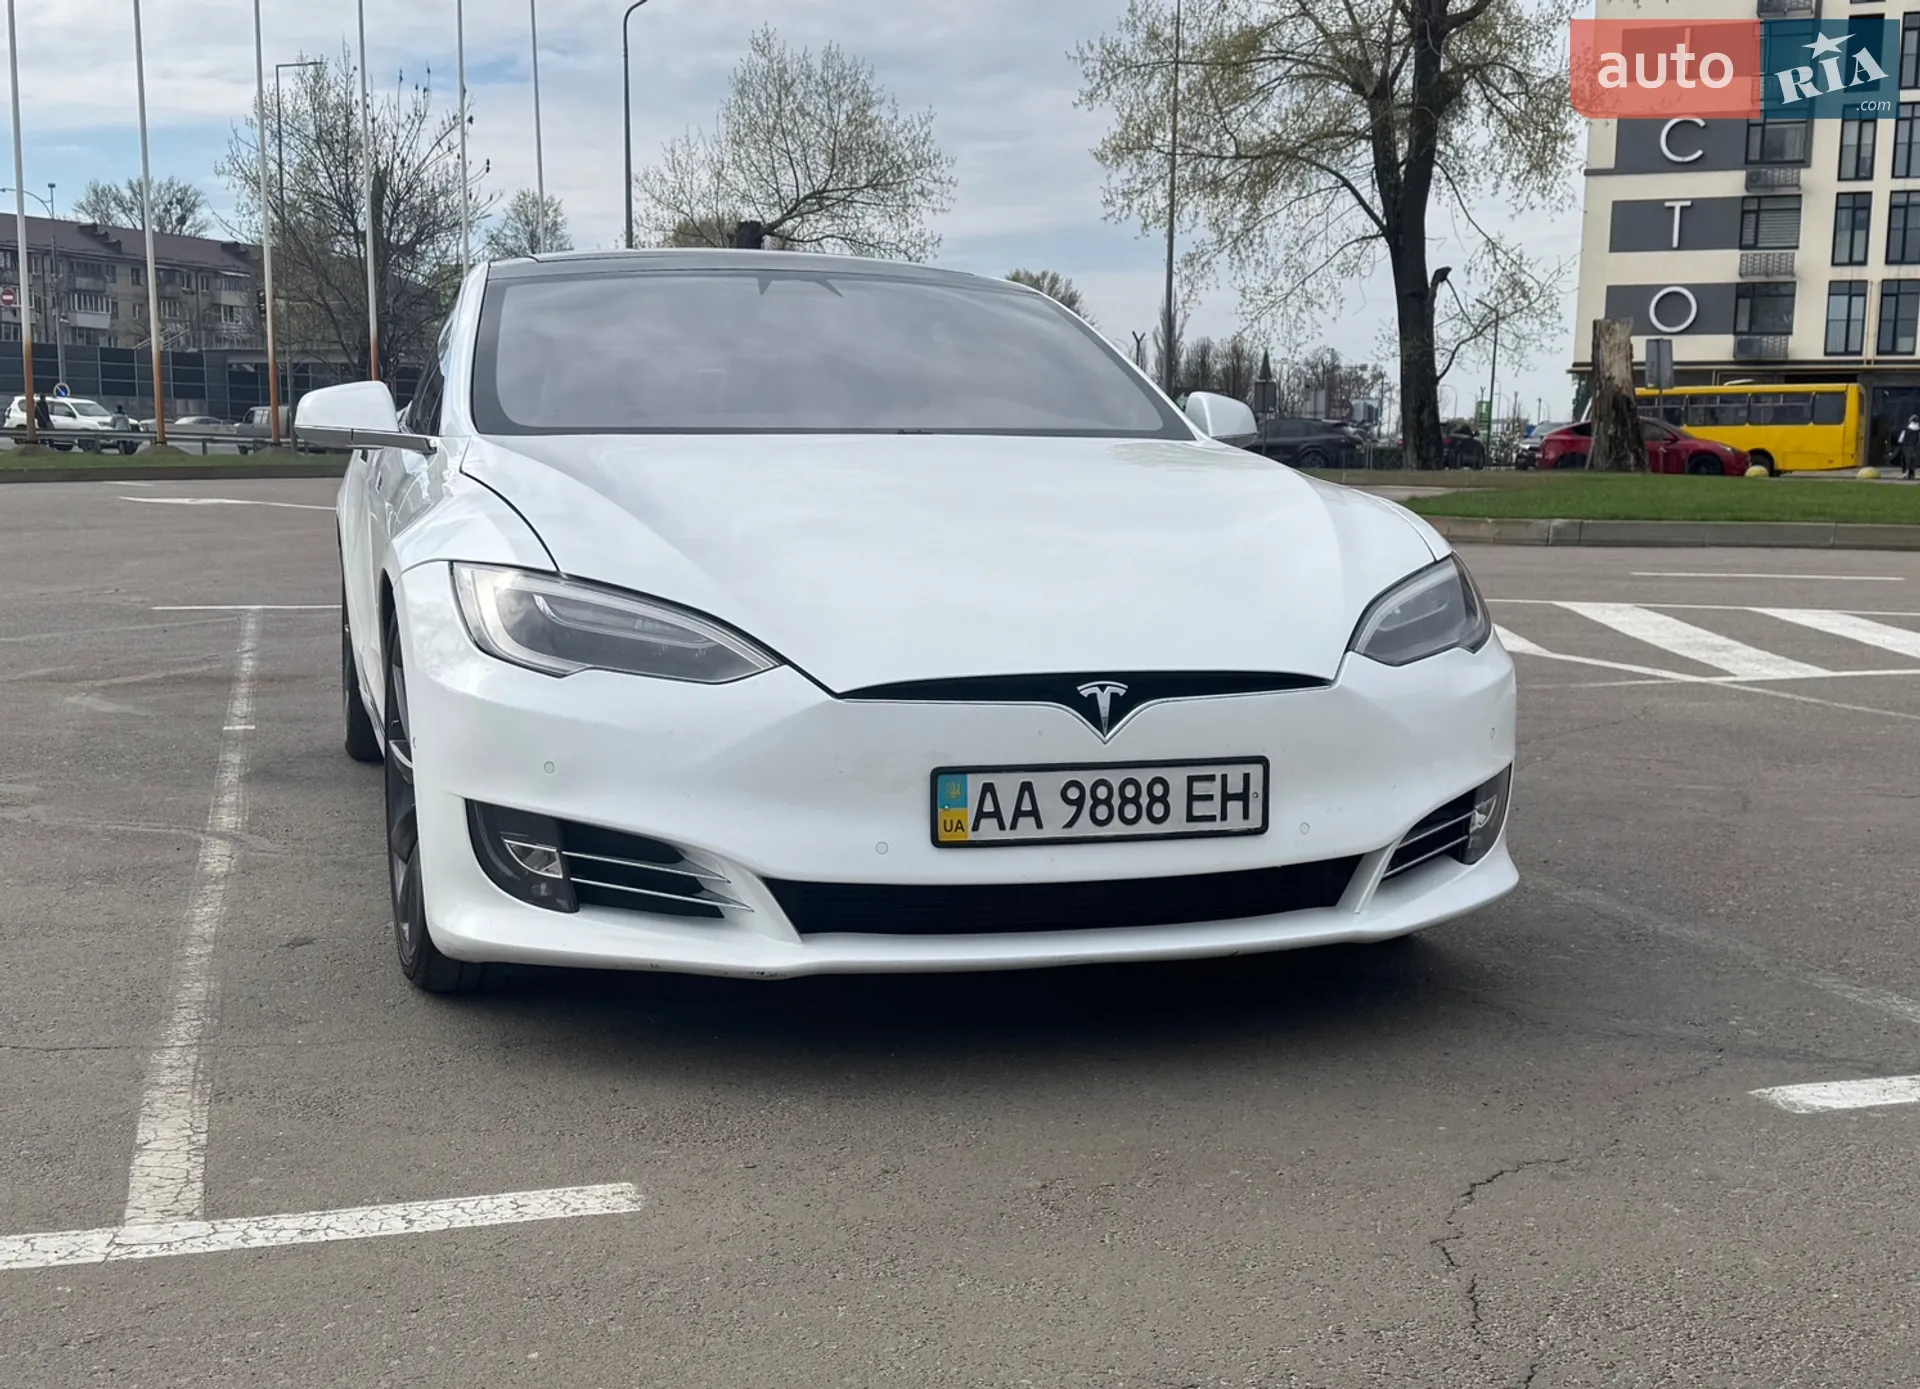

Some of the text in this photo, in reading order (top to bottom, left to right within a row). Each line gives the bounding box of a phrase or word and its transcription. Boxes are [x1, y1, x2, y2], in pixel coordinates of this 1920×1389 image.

[970, 772, 1251, 832] AA 9888 EH
[943, 818, 966, 834] UA
